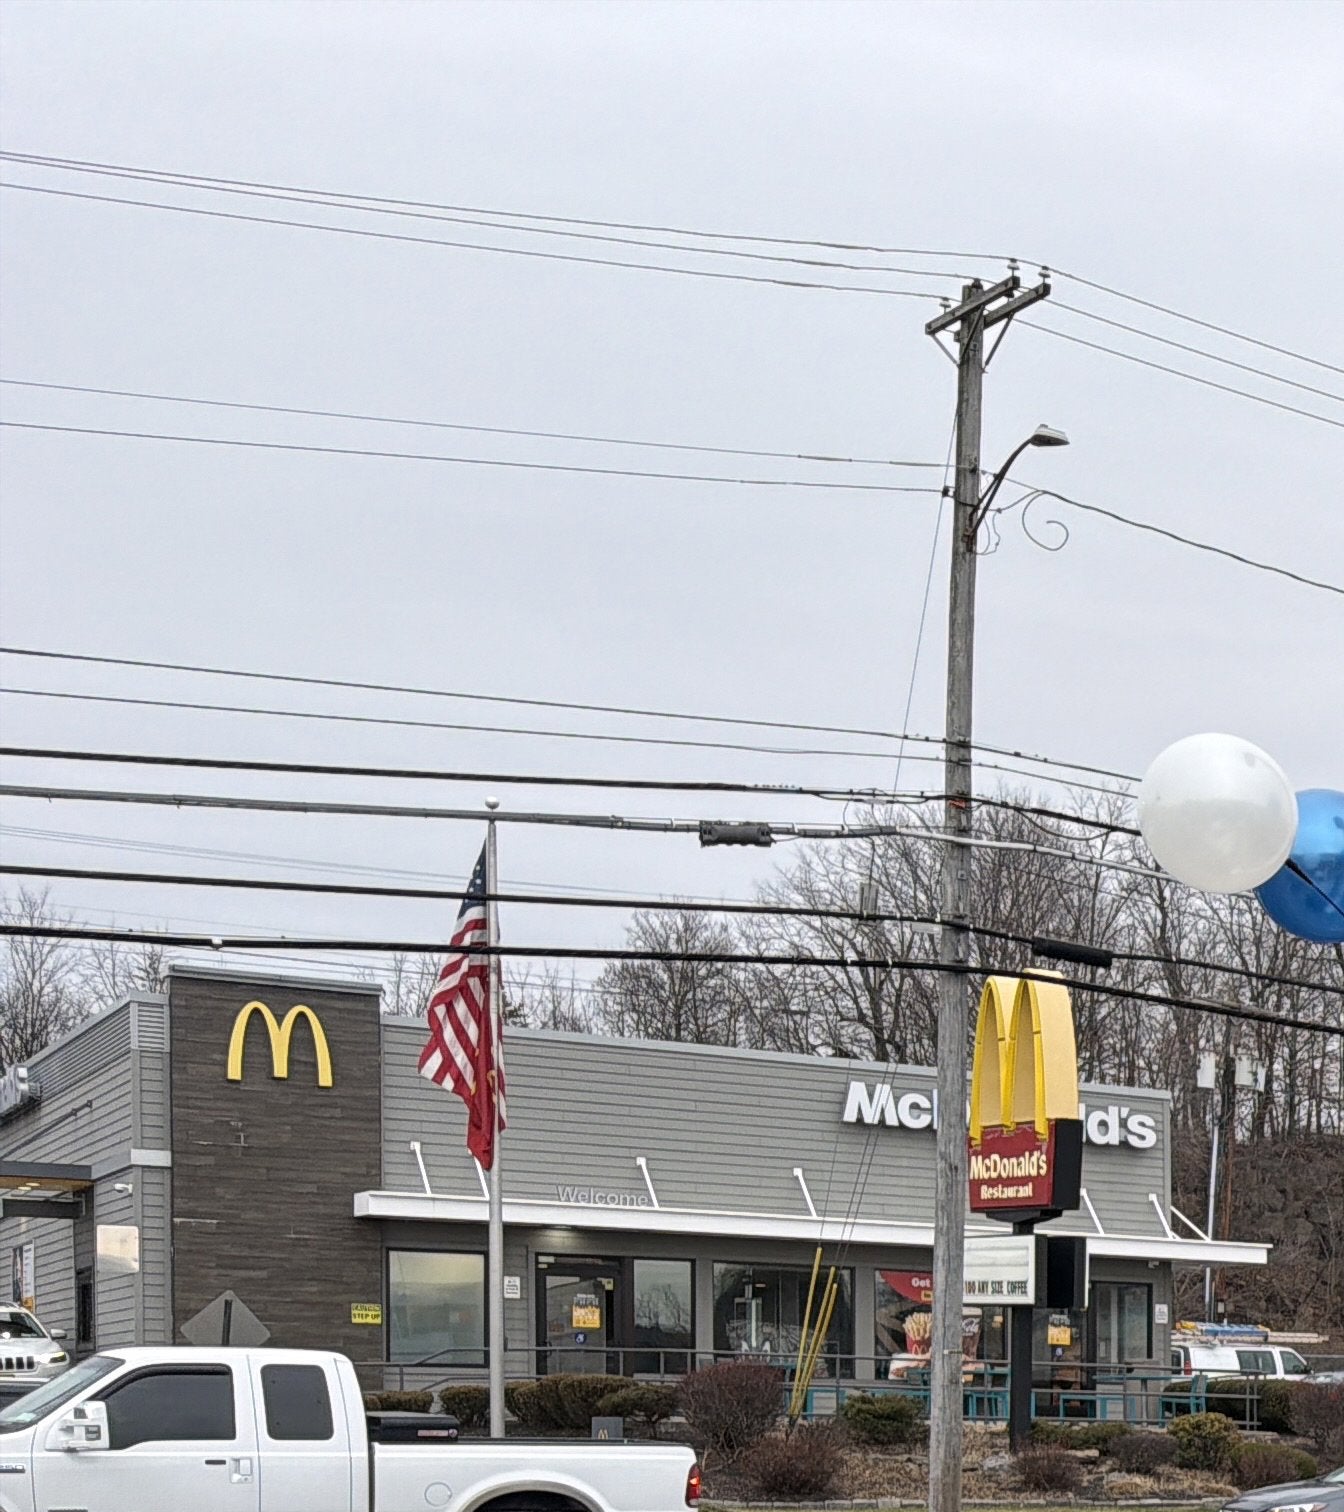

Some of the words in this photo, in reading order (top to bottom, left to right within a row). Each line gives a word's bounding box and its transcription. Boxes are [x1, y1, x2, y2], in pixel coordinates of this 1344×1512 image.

[843, 1077, 1157, 1149] Mcld's
[969, 1149, 1048, 1180] McDonald's
[555, 1184, 649, 1208] Welcome
[980, 1182, 1033, 1200] Restaurant
